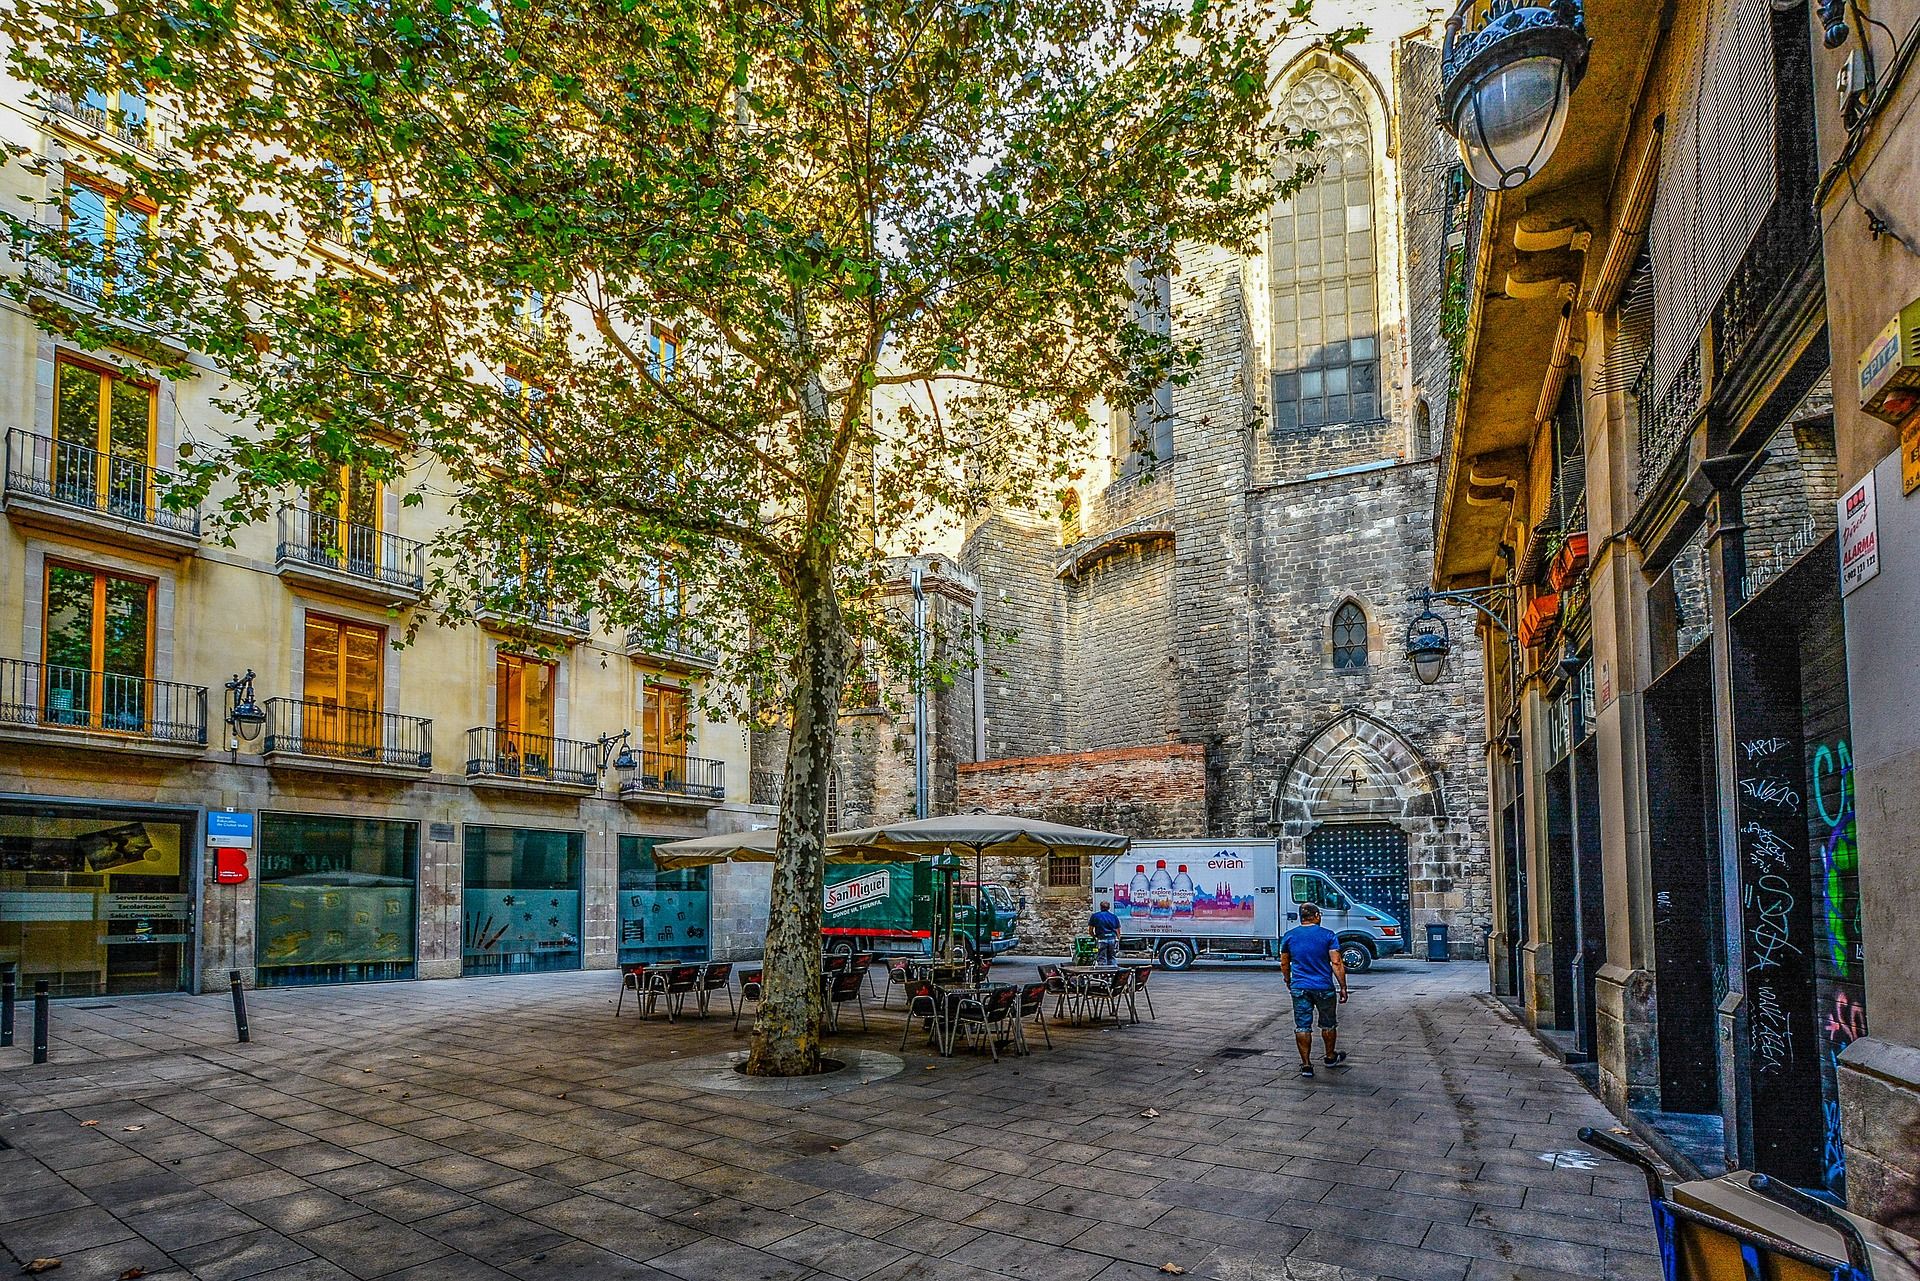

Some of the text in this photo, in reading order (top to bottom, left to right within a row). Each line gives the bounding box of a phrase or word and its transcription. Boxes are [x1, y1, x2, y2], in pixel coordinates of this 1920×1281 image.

[1863, 339, 1895, 385] SPITZ
[1843, 531, 1875, 566] ALARMA
[1741, 559, 1771, 600] tapes
[1775, 542, 1784, 572] &
[1207, 858, 1243, 869] evian
[832, 909, 850, 919] DONDE
